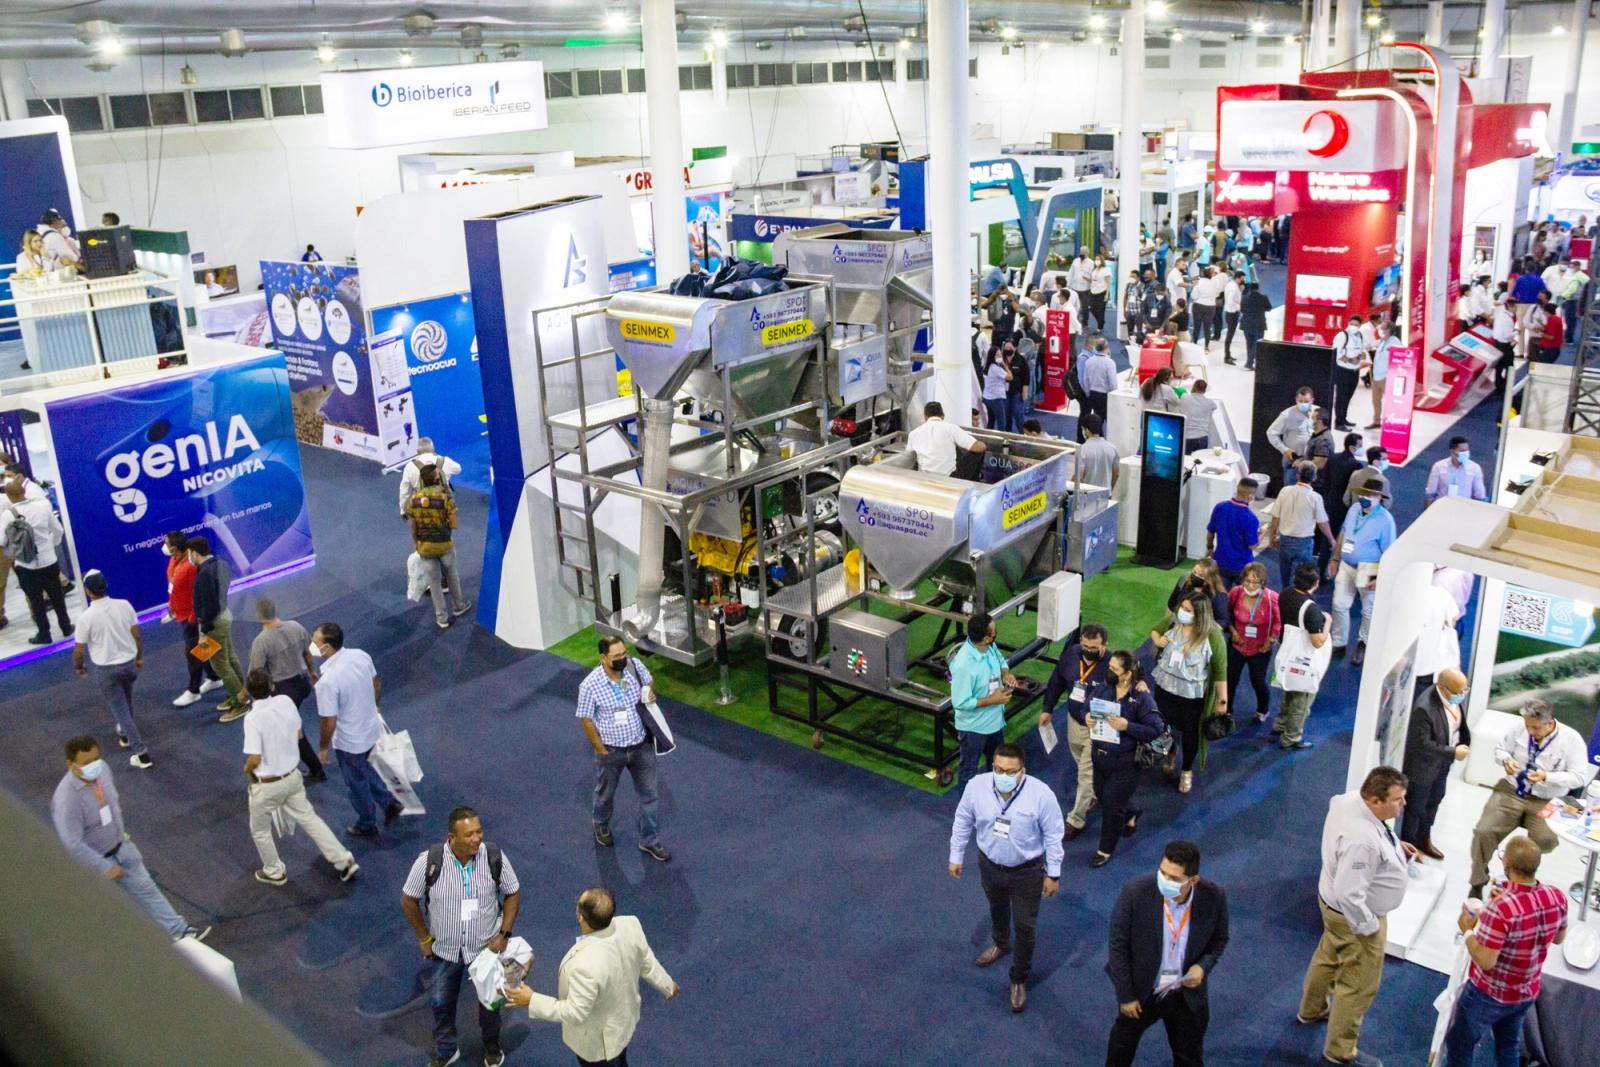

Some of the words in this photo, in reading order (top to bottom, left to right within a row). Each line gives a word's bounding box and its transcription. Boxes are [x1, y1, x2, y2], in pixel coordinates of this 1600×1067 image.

[397, 83, 472, 102] Bioiberica
[453, 102, 498, 117] IBERIAN
[500, 101, 531, 113] FEED
[625, 323, 670, 339] SEINMEX
[767, 323, 807, 341] SEINMEX
[182, 458, 265, 492] NICOVITA
[1008, 499, 1042, 523] SEINMEX
[123, 543, 135, 553] Tu
[180, 517, 219, 535] maronero
[232, 510, 245, 519] tus
[246, 501, 273, 516] manos
